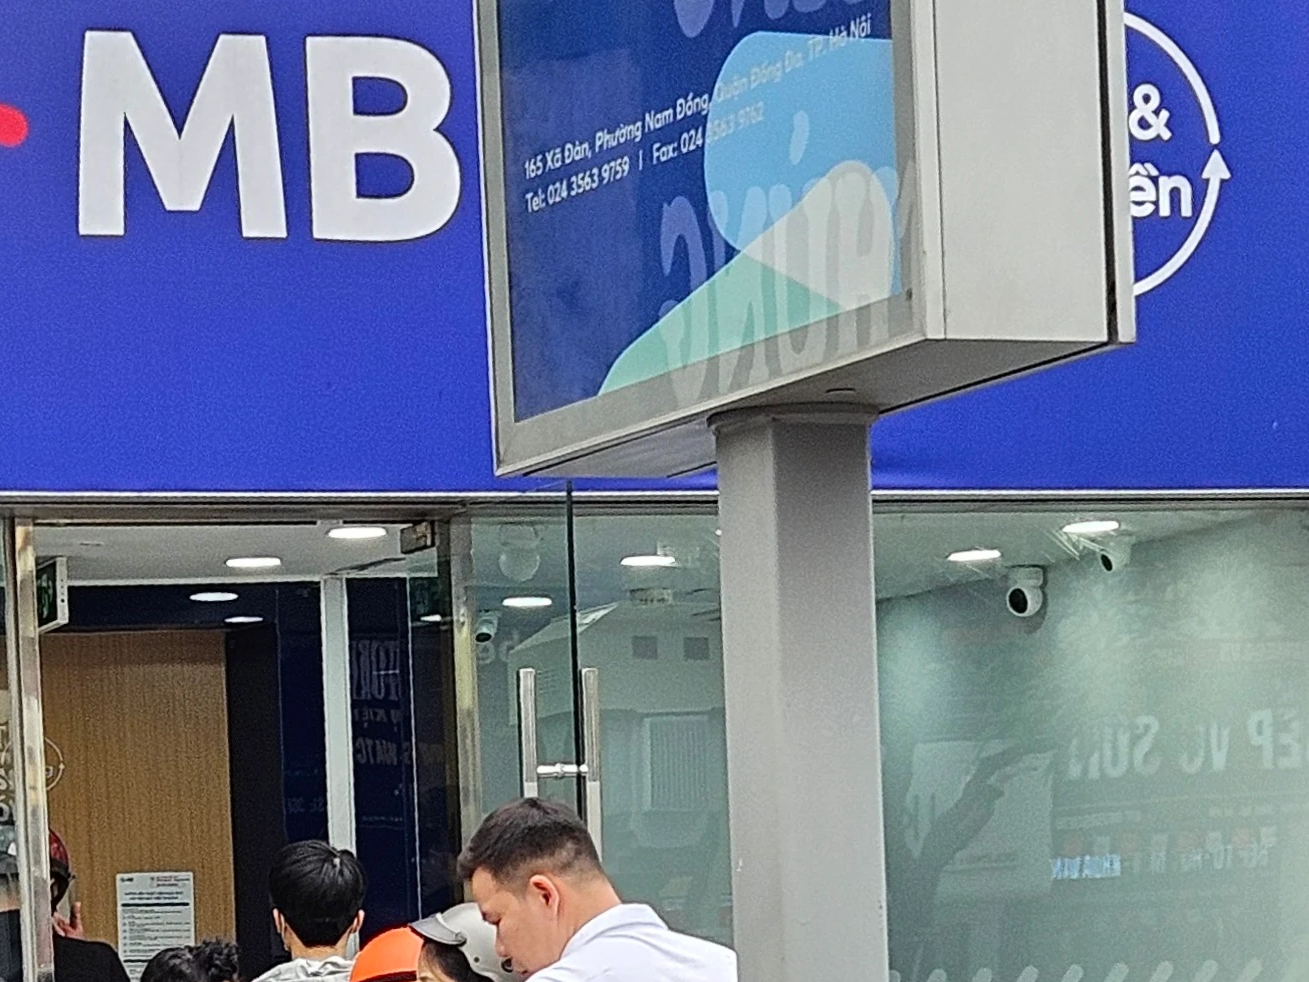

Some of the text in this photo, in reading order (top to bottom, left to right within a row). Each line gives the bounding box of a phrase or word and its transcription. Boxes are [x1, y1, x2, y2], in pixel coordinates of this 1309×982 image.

[78, 30, 463, 242] MB
[524, 157, 544, 180] 165
[594, 120, 642, 152] Phường
[644, 108, 674, 133] Nam
[1129, 84, 1172, 141] &
[547, 181, 568, 205] 024
[570, 170, 600, 197] 3563
[601, 156, 631, 184] 9759
[652, 141, 679, 165] Fax:
[680, 127, 703, 154] 024
[1130, 161, 1193, 218] ền
